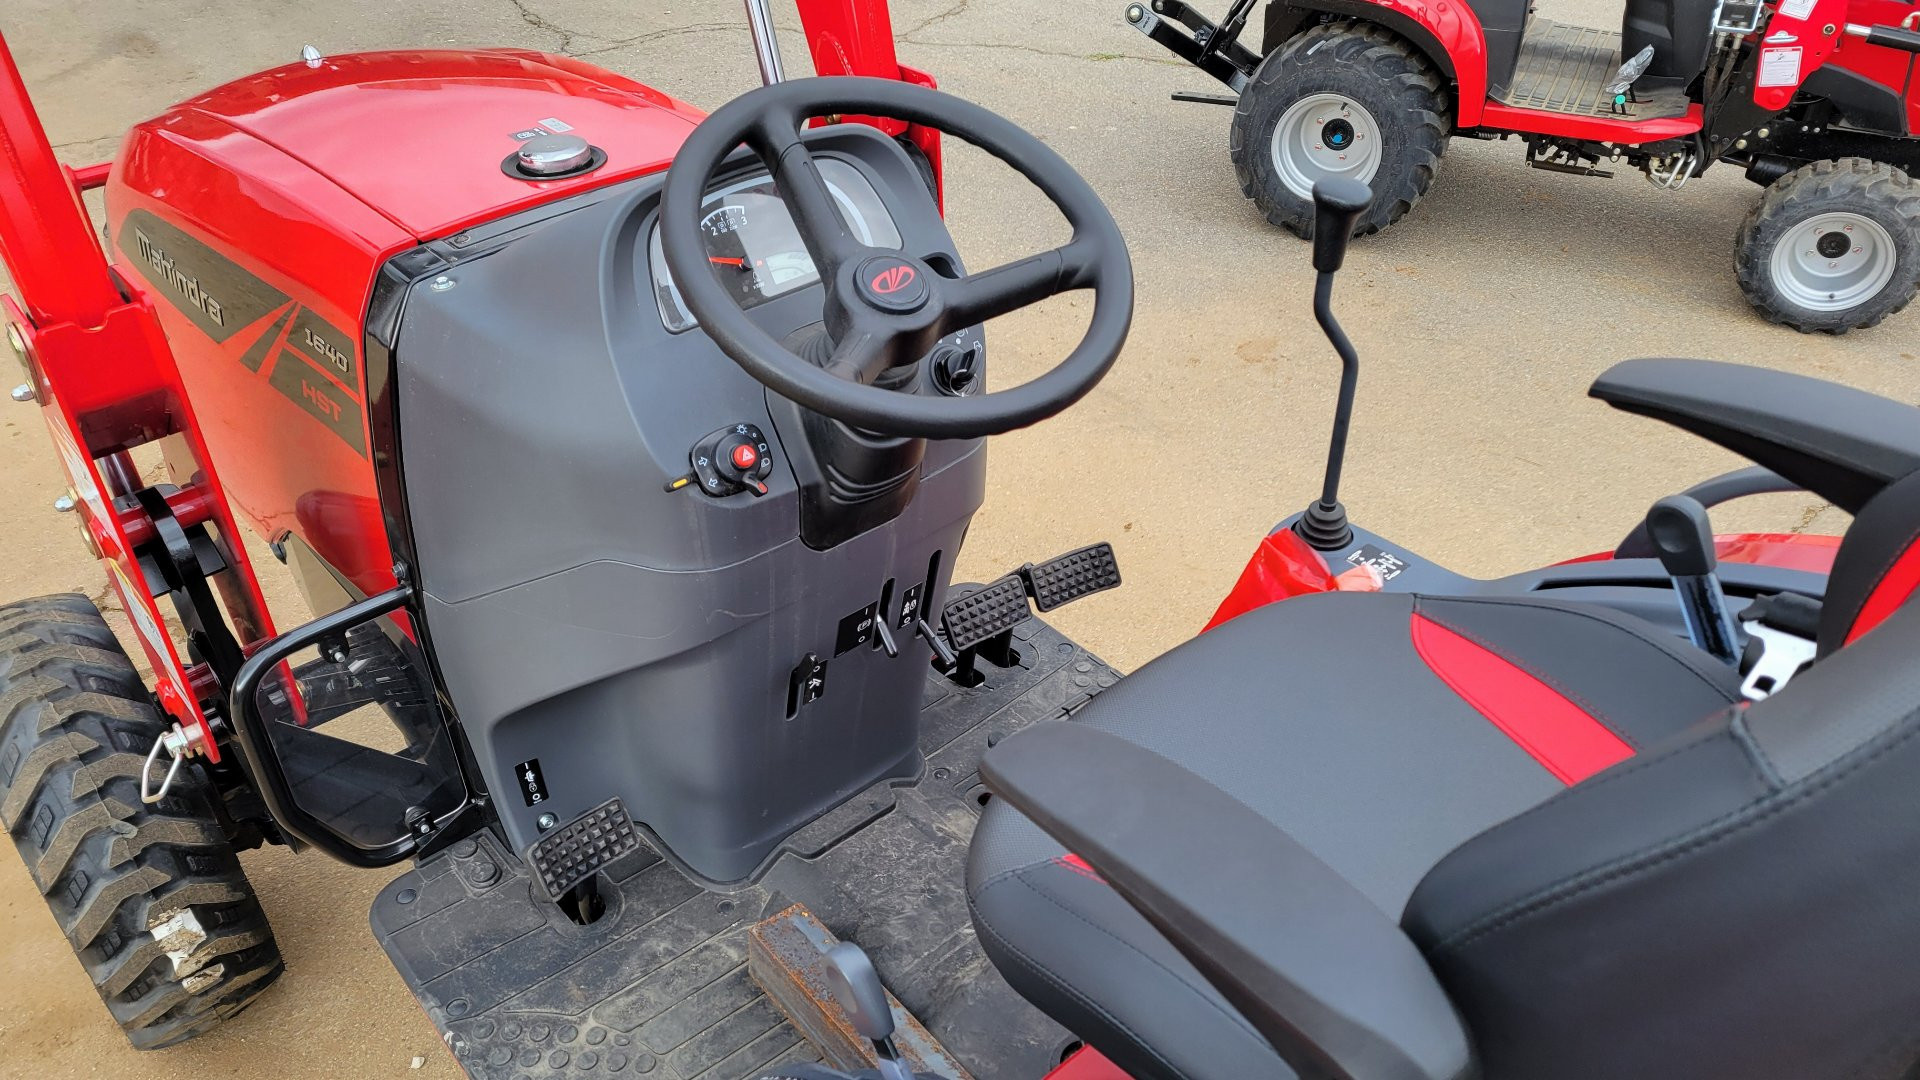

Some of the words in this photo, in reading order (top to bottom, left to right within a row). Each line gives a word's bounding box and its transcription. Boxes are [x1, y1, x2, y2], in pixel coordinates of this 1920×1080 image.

[711, 227, 718, 236] 2
[741, 216, 748, 225] 3
[135, 226, 225, 327] Mahindra
[304, 327, 349, 373] 1640
[301, 379, 342, 422] HST
